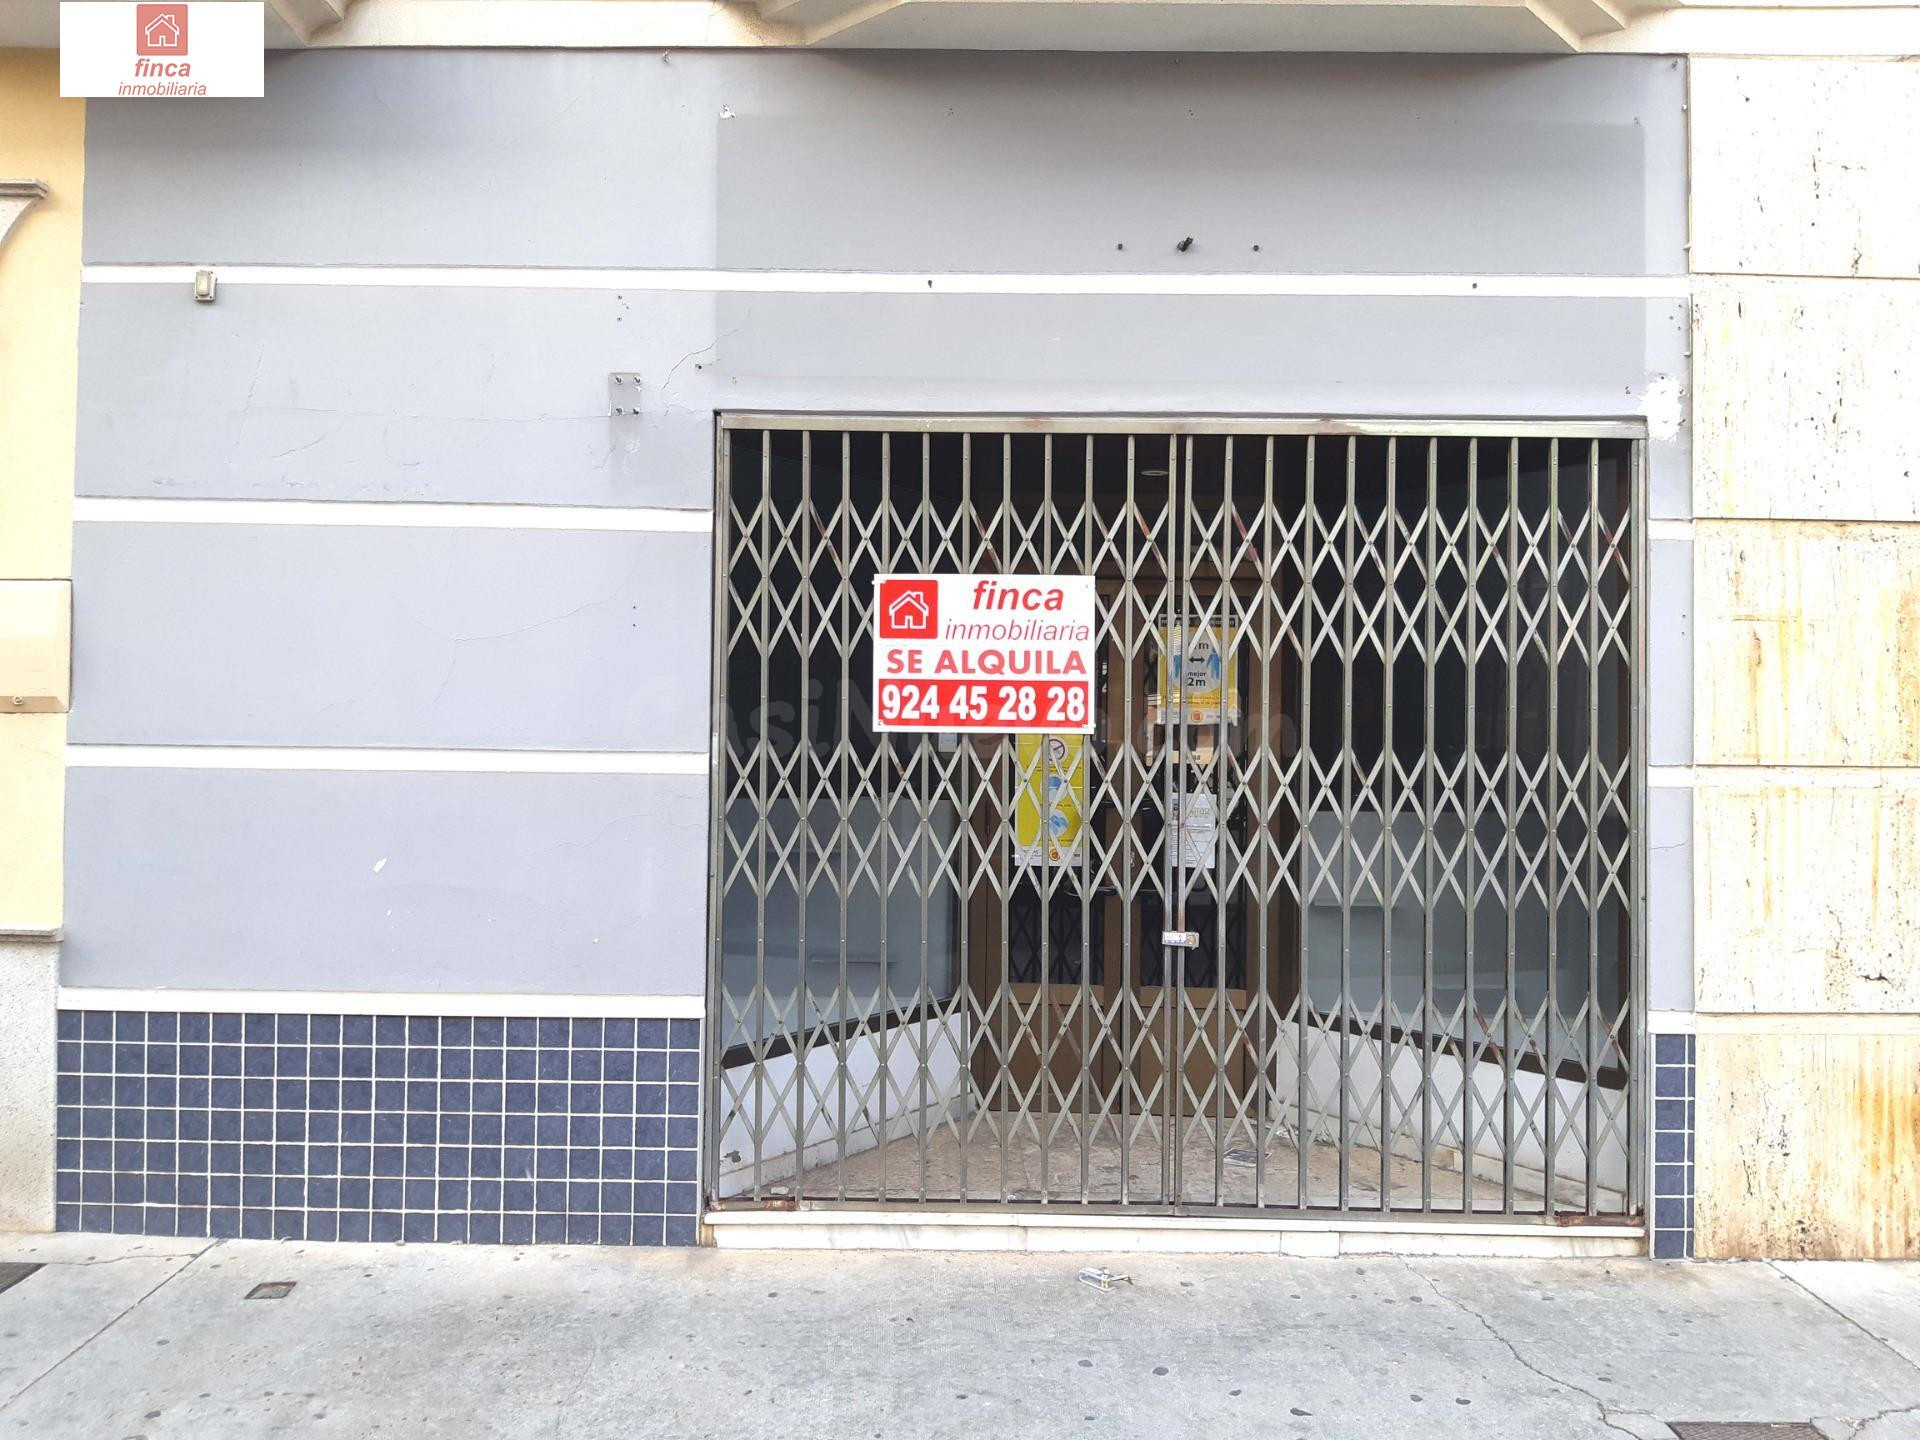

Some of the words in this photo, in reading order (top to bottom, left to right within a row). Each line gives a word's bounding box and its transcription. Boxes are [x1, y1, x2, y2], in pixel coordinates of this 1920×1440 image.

[972, 580, 1064, 611] finca
[945, 618, 1090, 641] inmobiliaria
[886, 648, 923, 674] SE
[934, 649, 1087, 675] ALQUILA
[881, 684, 940, 719] 924
[949, 685, 989, 720] 45
[997, 685, 1037, 721] 28
[1046, 686, 1086, 721] 28
